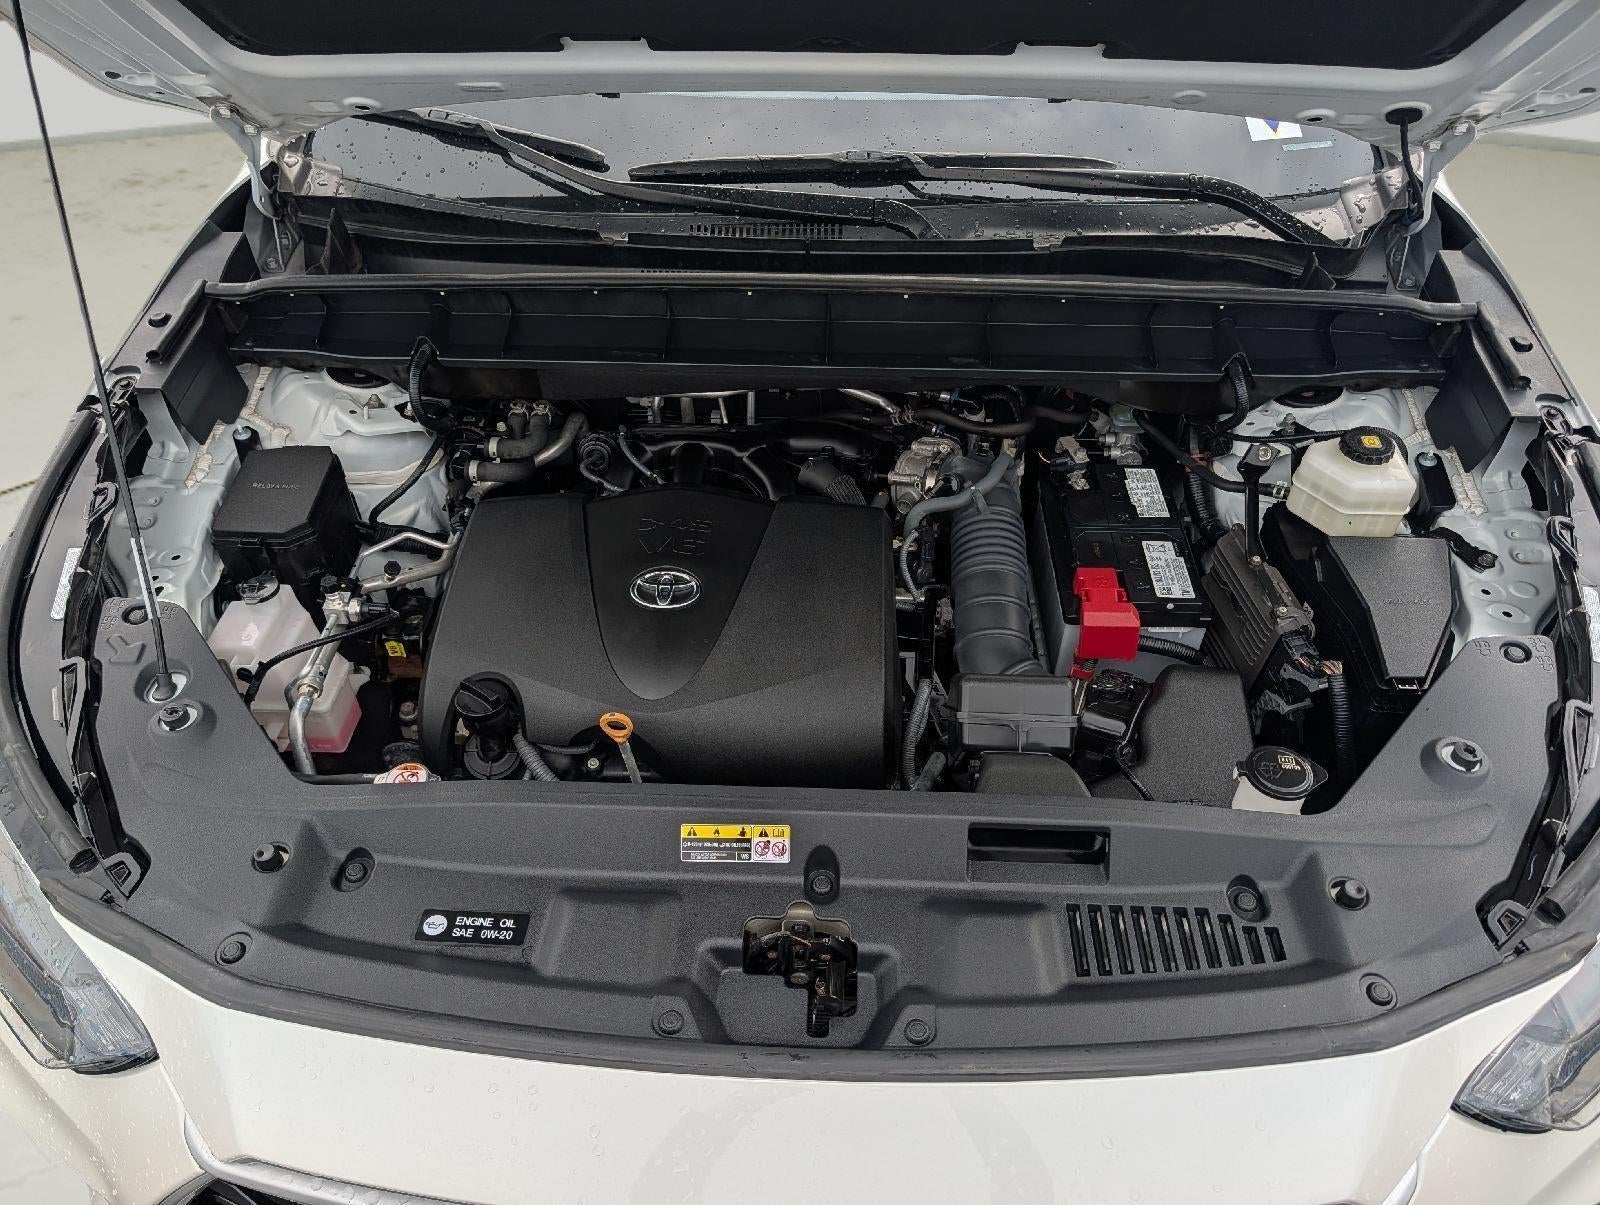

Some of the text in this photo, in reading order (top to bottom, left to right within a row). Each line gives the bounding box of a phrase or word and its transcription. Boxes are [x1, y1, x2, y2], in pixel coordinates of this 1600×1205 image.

[454, 916, 517, 929] ENGINE OIL
[451, 927, 514, 940] SAE 0W-20
